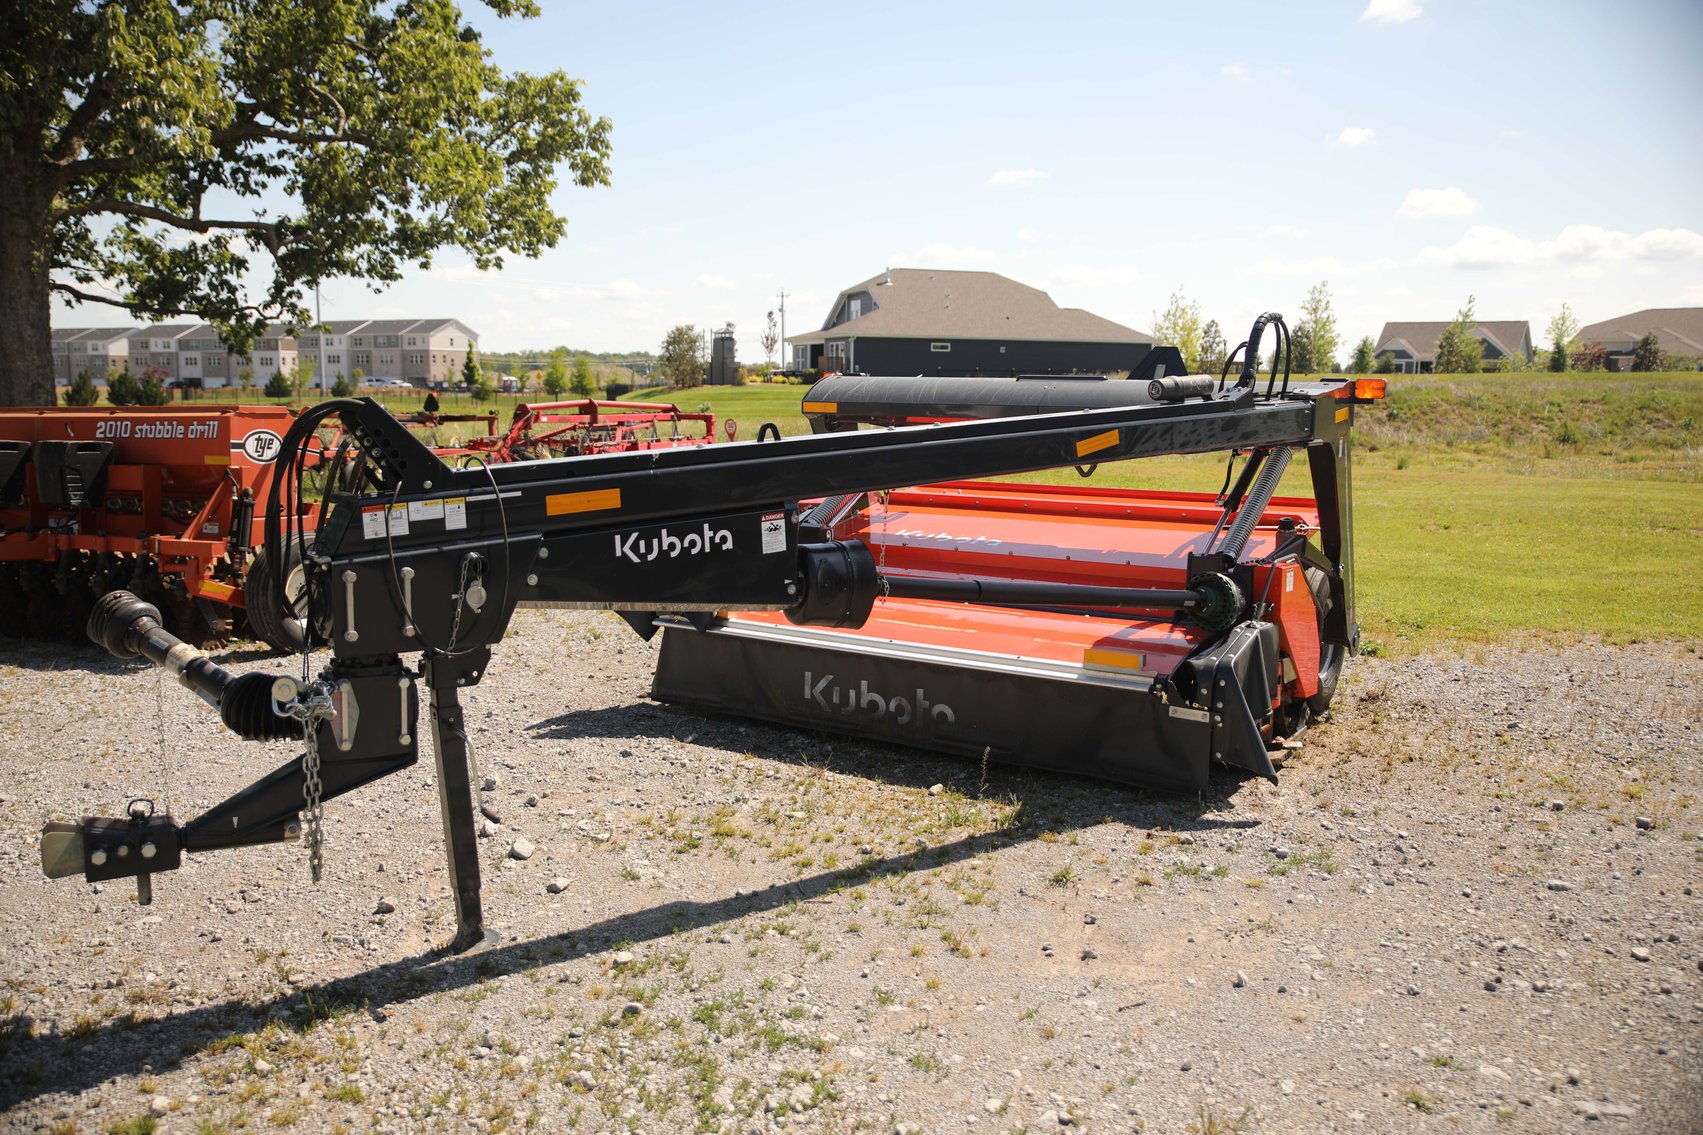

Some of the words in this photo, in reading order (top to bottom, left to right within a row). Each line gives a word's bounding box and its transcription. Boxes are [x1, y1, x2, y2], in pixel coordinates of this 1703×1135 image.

[95, 421, 131, 438] 2010
[134, 421, 185, 438] stubble
[188, 421, 219, 438] drill
[254, 435, 274, 457] tye
[614, 523, 734, 563] Kubota
[895, 529, 1002, 546] Kubota
[804, 671, 955, 728] Kubota
